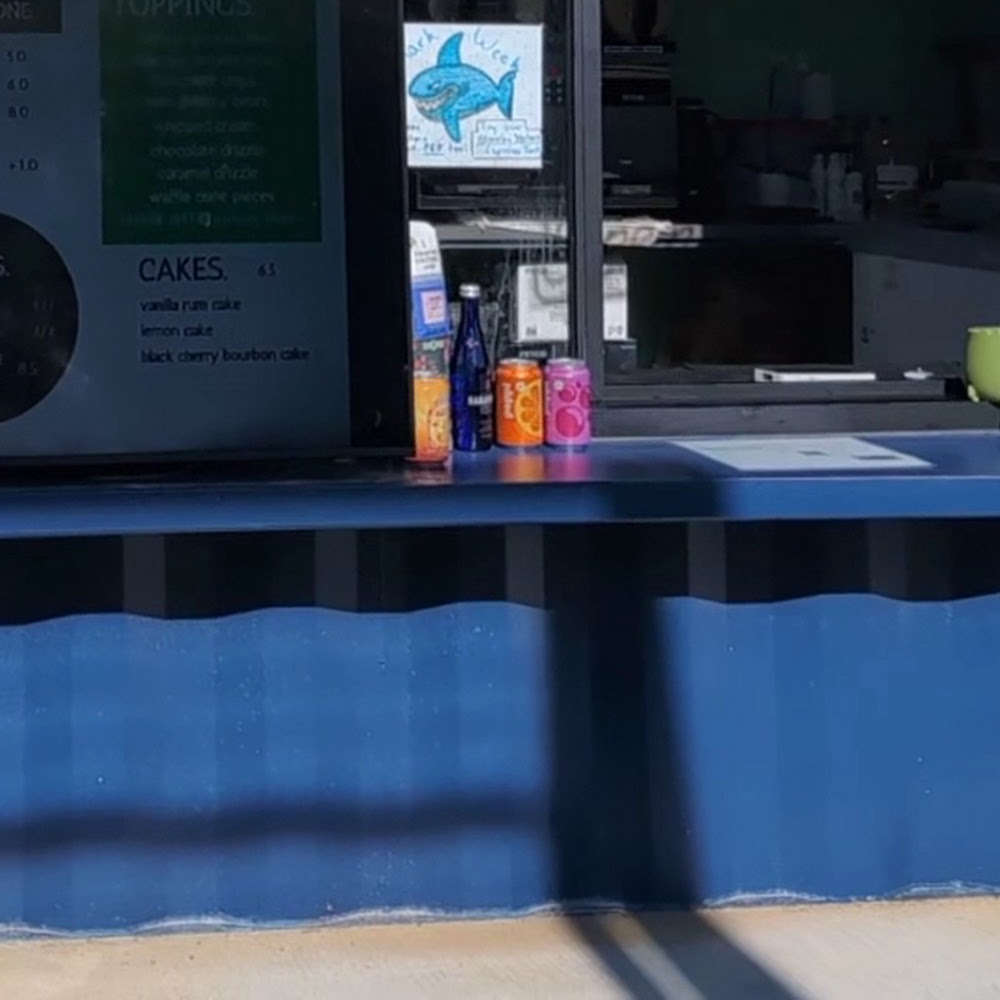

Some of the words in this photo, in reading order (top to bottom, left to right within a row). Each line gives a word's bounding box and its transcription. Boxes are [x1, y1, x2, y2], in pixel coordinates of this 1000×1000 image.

[138, 256, 228, 282] CAKES.
[140, 299, 179, 312] vanilla
[182, 301, 208, 312] rum
[211, 298, 241, 311] cake
[140, 323, 180, 337] lemon
[183, 323, 214, 337] cake
[140, 350, 173, 364] black
[178, 351, 219, 365] cherry
[223, 349, 277, 362] bourbon
[280, 348, 310, 361] cake
